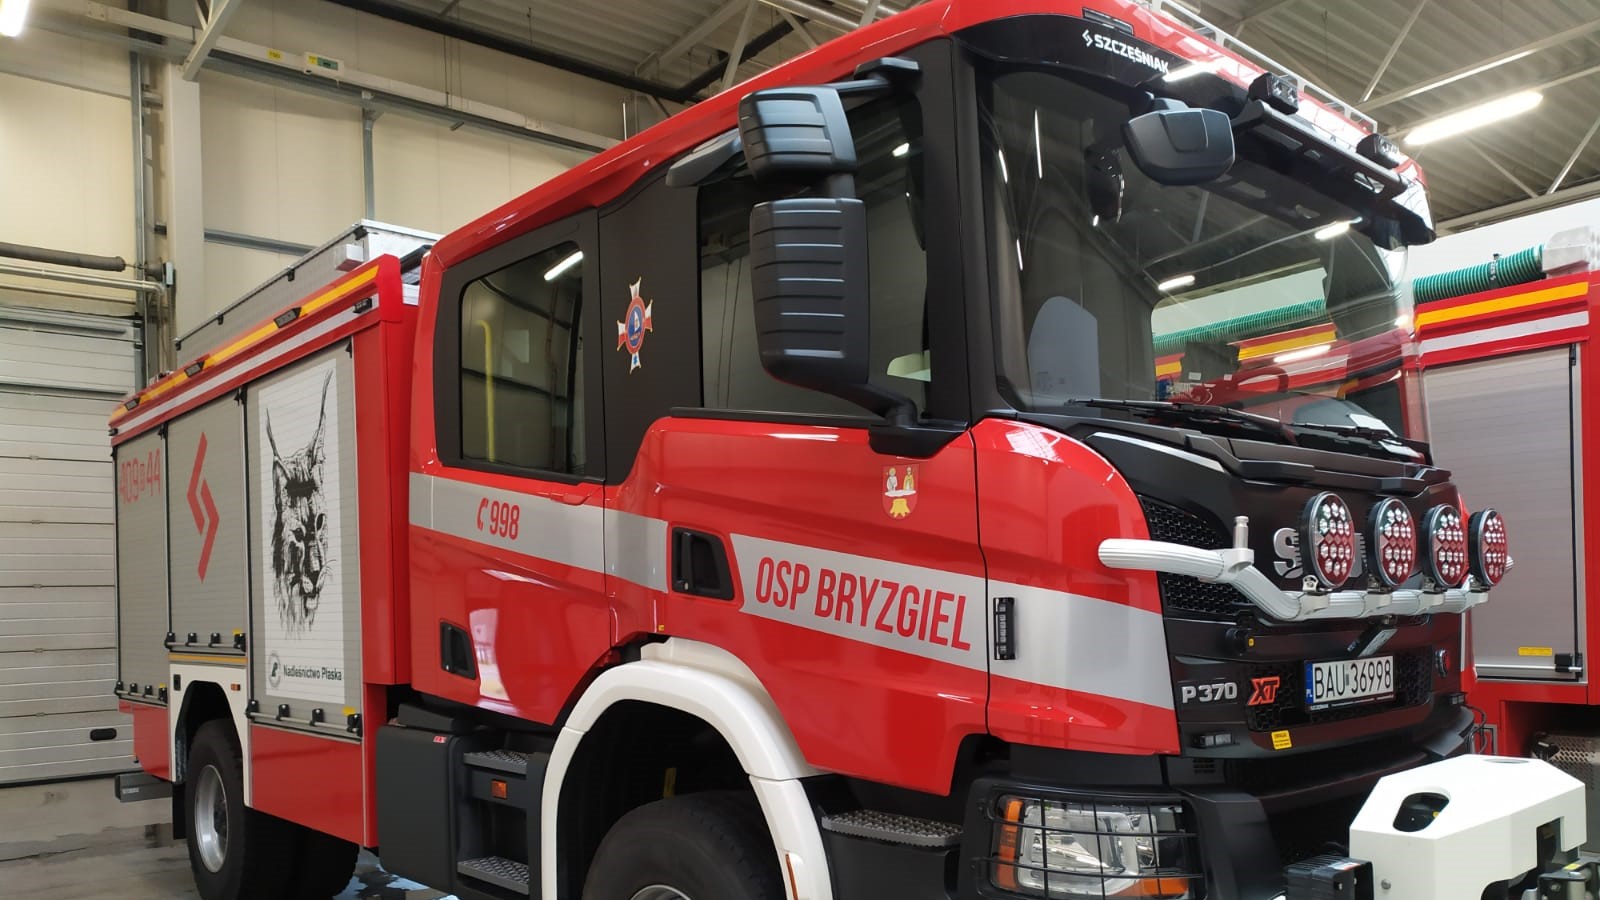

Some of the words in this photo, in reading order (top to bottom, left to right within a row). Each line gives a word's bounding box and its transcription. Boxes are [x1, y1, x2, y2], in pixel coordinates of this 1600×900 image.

[1094, 34, 1169, 74] SZCZĘŚNIAK
[489, 500, 520, 540] 998
[755, 556, 811, 611] OSP
[814, 568, 971, 652] BRYZGIEL
[1247, 676, 1281, 706] XT
[1314, 664, 1346, 700] BAU
[1350, 659, 1392, 695] 36998
